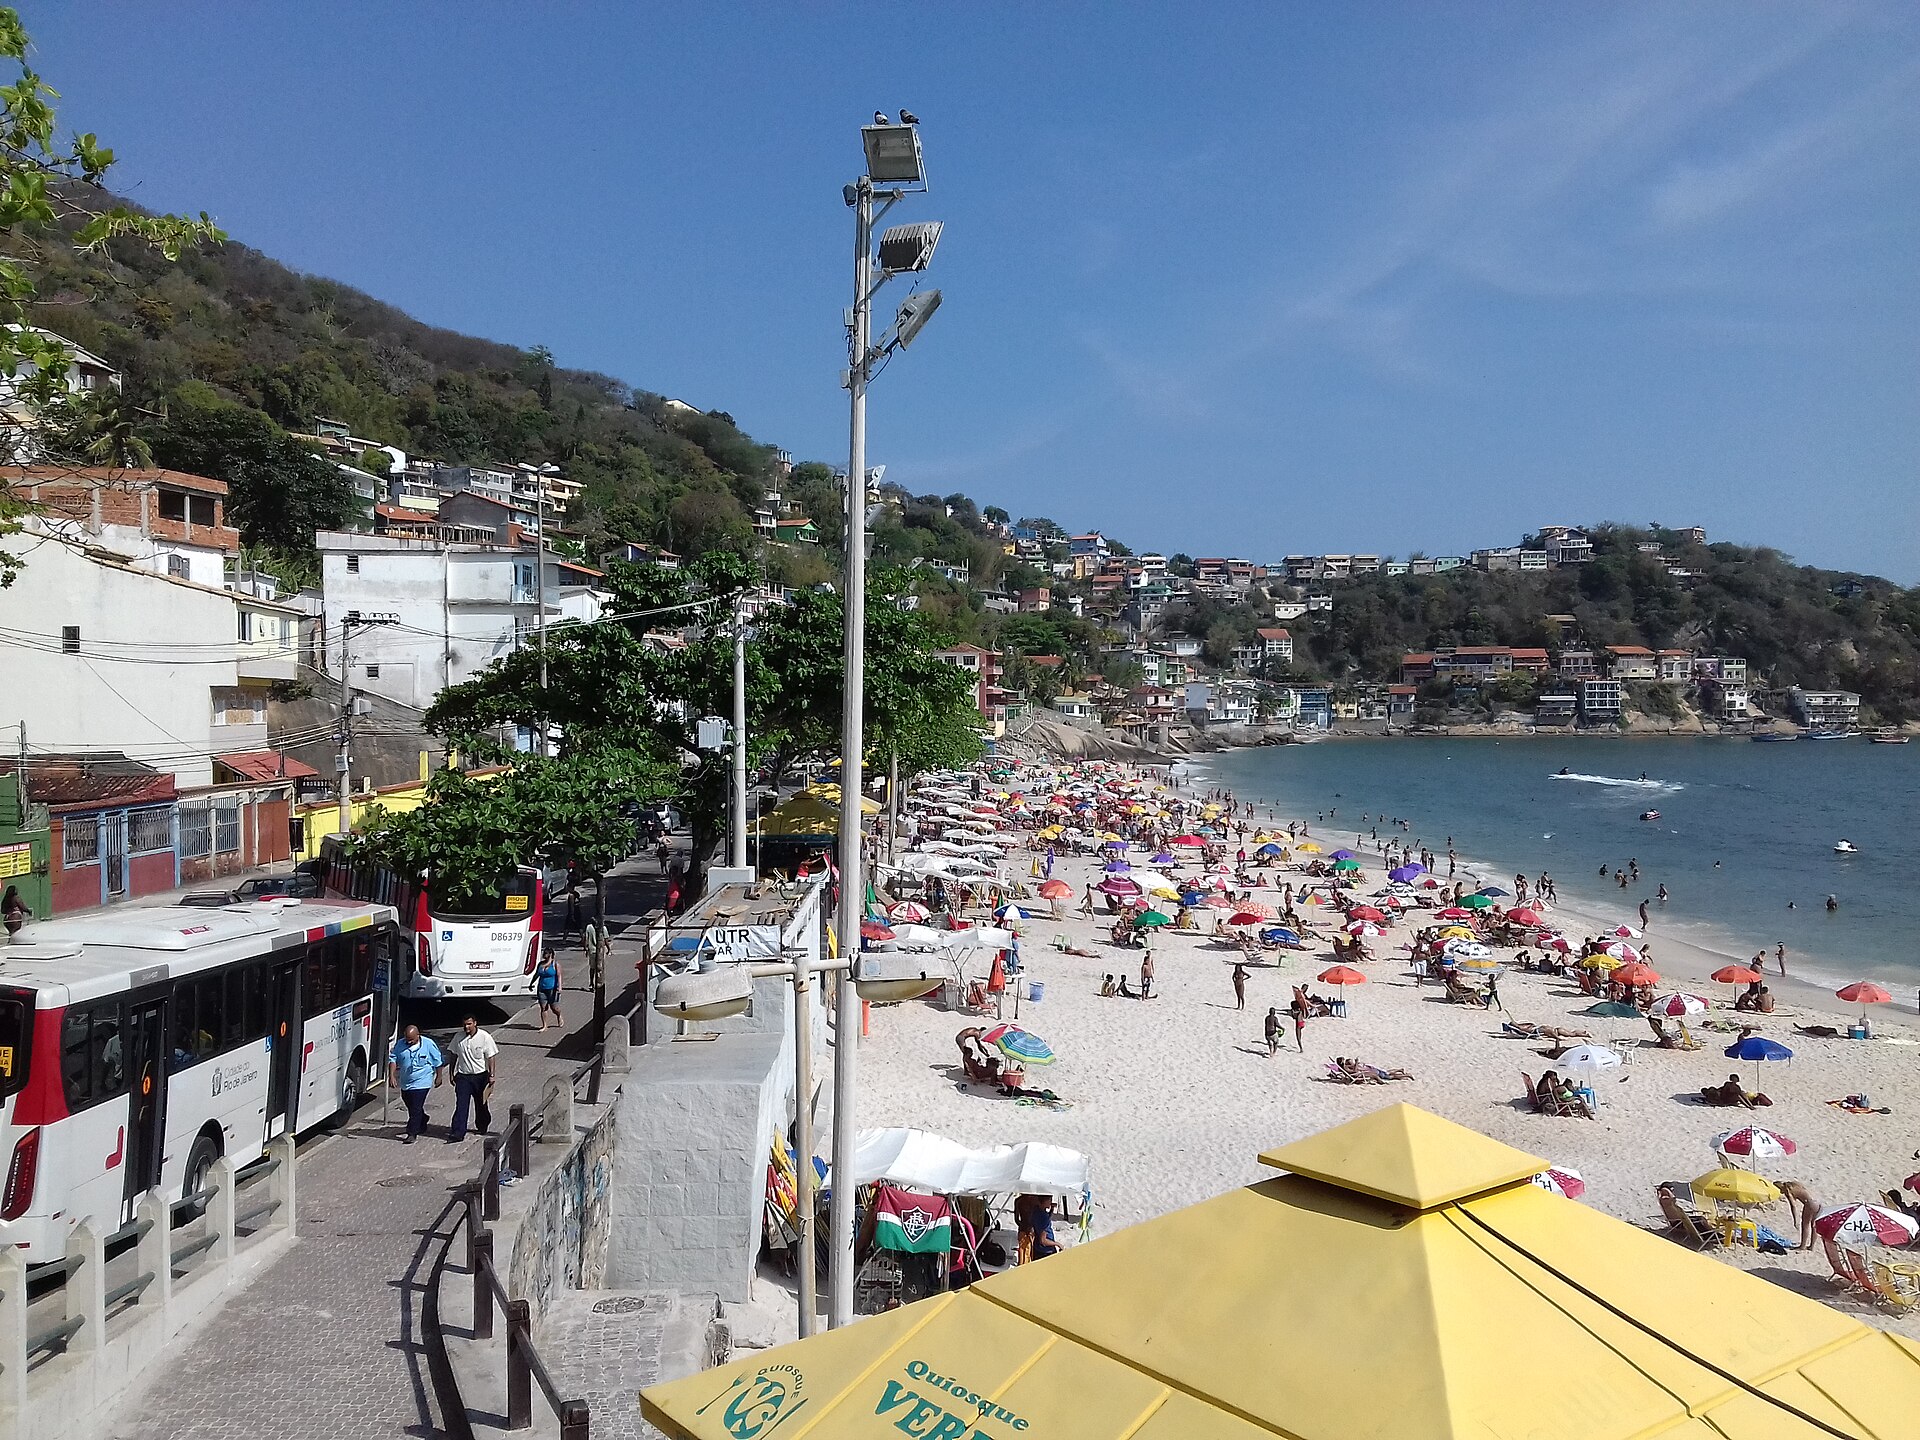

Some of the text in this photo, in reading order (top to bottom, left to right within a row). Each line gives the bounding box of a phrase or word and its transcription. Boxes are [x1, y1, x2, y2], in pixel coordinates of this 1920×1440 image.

[491, 932, 522, 941] D86379
[715, 929, 750, 943] UTR
[757, 1364, 803, 1399] QUIOSQUE
[904, 1360, 1030, 1431] Quiosque
